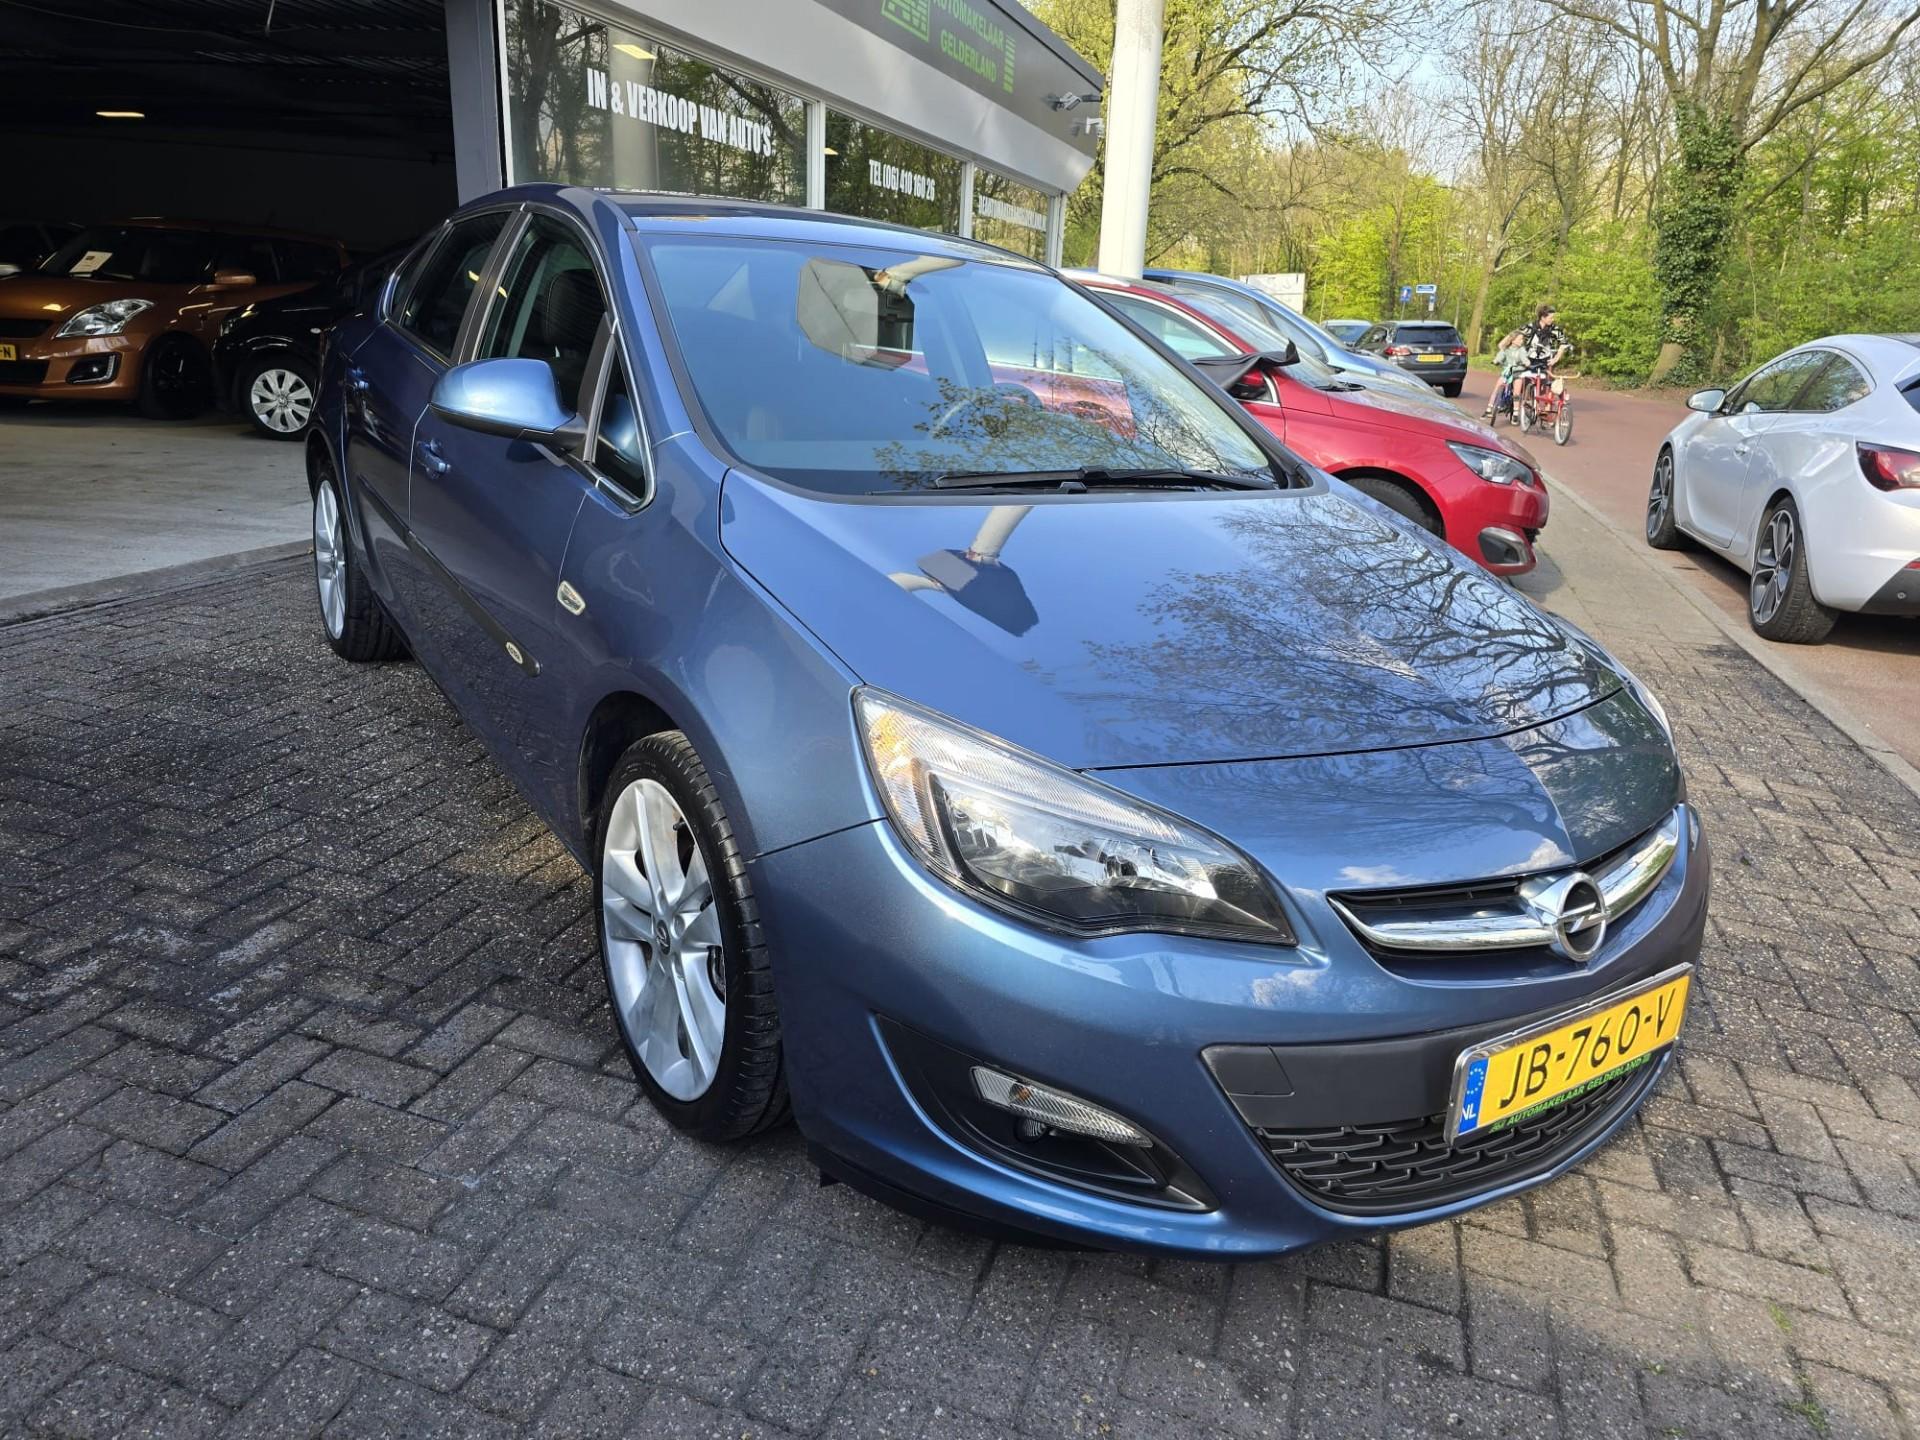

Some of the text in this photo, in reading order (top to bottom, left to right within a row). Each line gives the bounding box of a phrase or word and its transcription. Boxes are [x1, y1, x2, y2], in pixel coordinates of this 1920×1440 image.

[941, 29, 997, 83] GELDERLAND
[587, 67, 771, 157] IN & VERKOOP VAN AUTO'S
[868, 159, 882, 187] TEL
[883, 163, 899, 193] (06)
[899, 169, 913, 195] 410
[926, 177, 936, 202] 26
[1499, 988, 1676, 1109] JB-760-V
[1462, 1103, 1477, 1121] NL
[1506, 1056, 1642, 1126] AUTOMAKELAAR GELDERLAND
